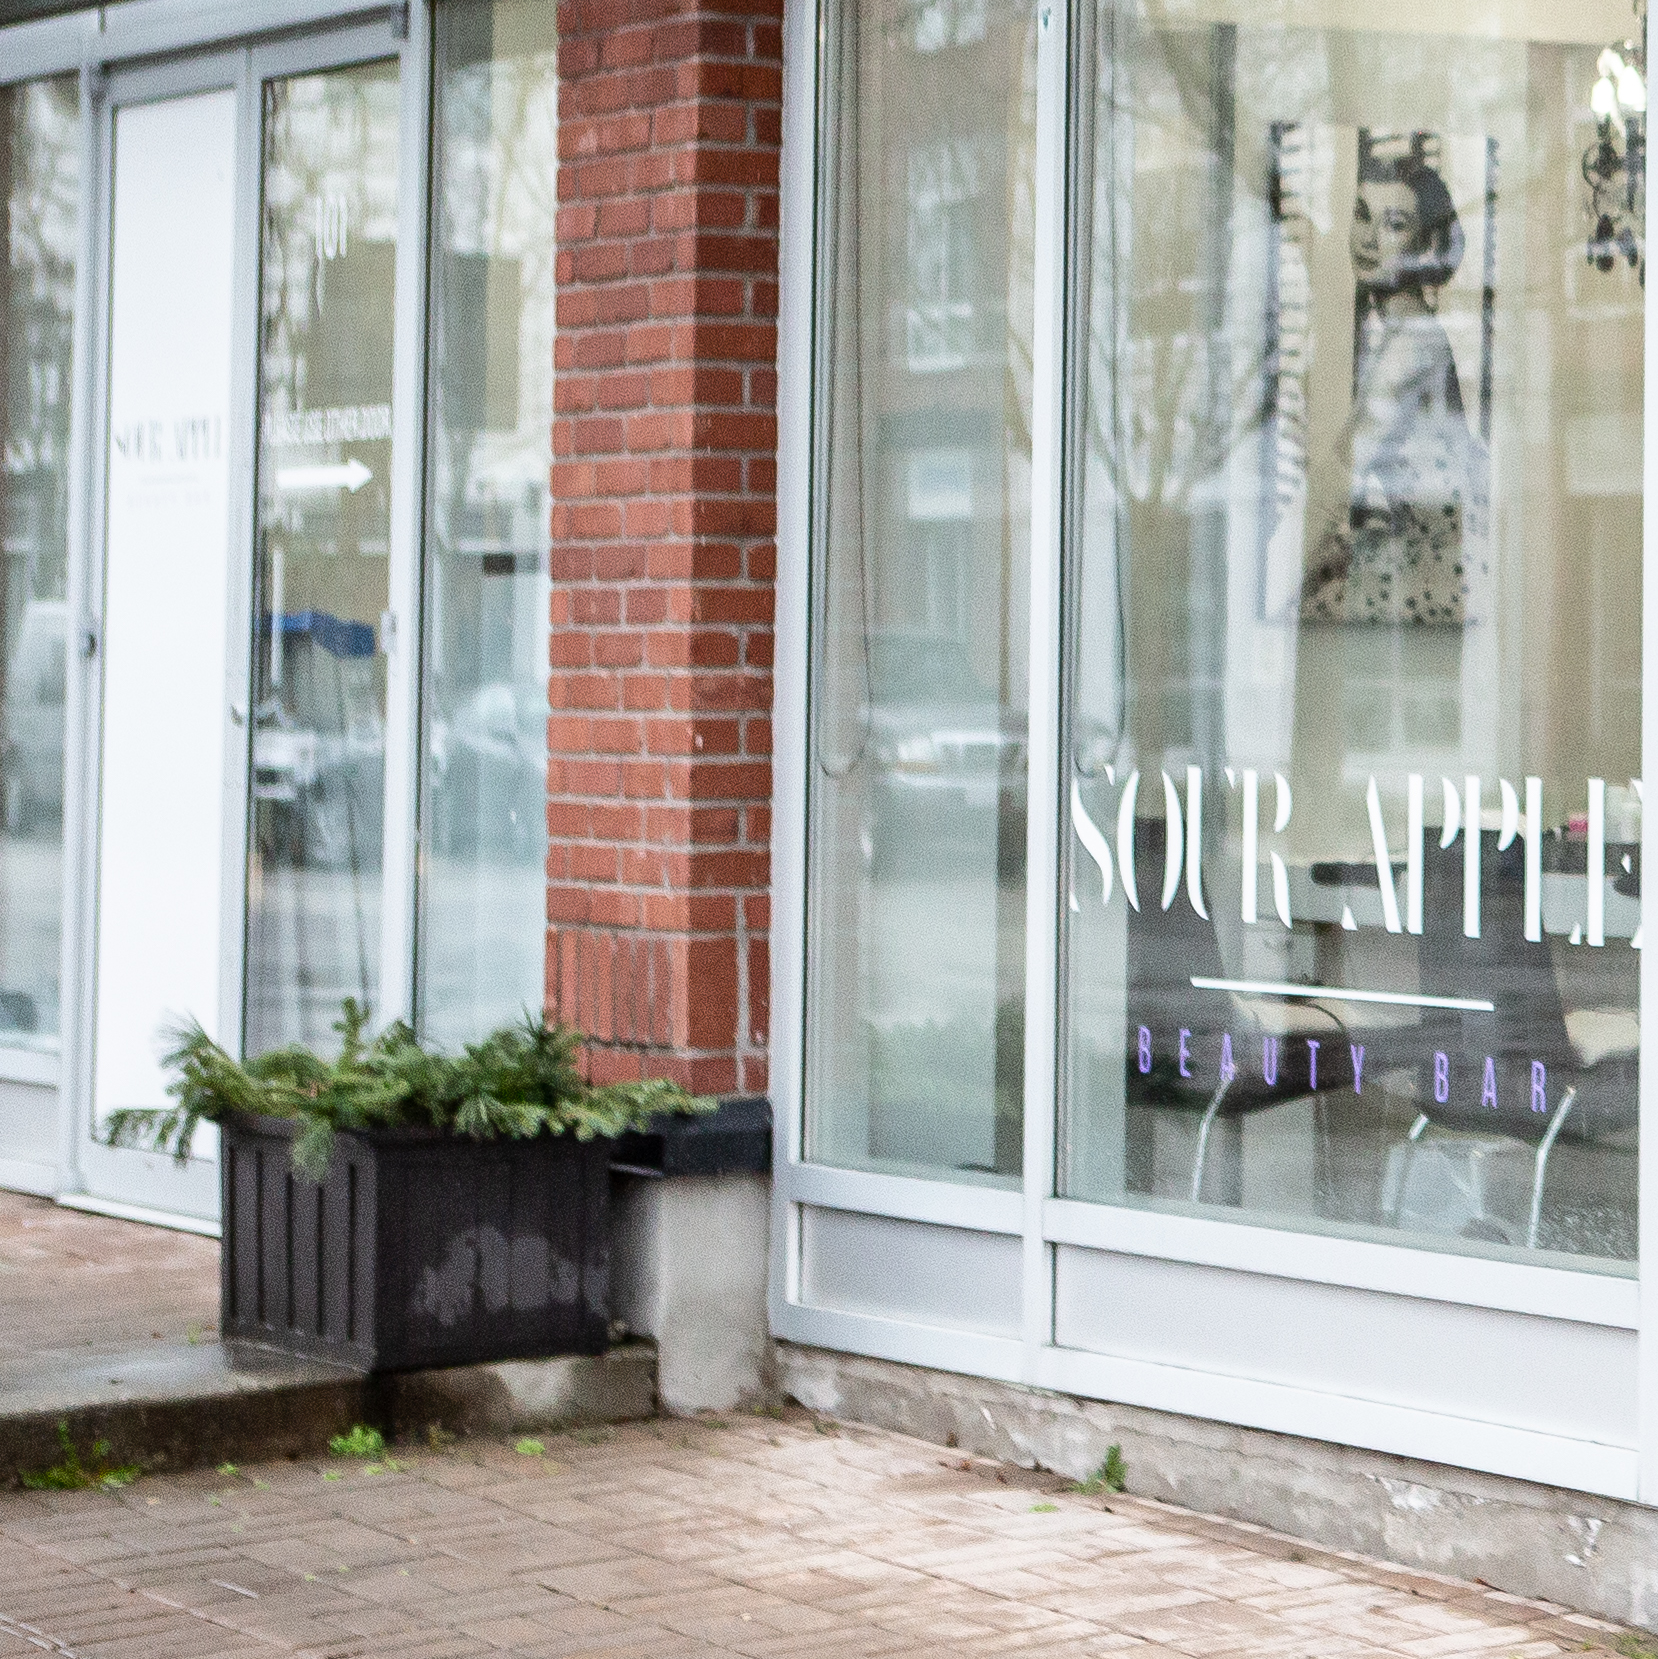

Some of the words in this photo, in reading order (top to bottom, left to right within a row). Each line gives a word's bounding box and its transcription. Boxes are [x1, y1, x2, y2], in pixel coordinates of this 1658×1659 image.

[1069, 765, 1293, 930] SOUR
[1342, 772, 1642, 950] APPLE
[1136, 1025, 1365, 1094] BEAUTY
[1433, 1051, 1548, 1113] BAR
